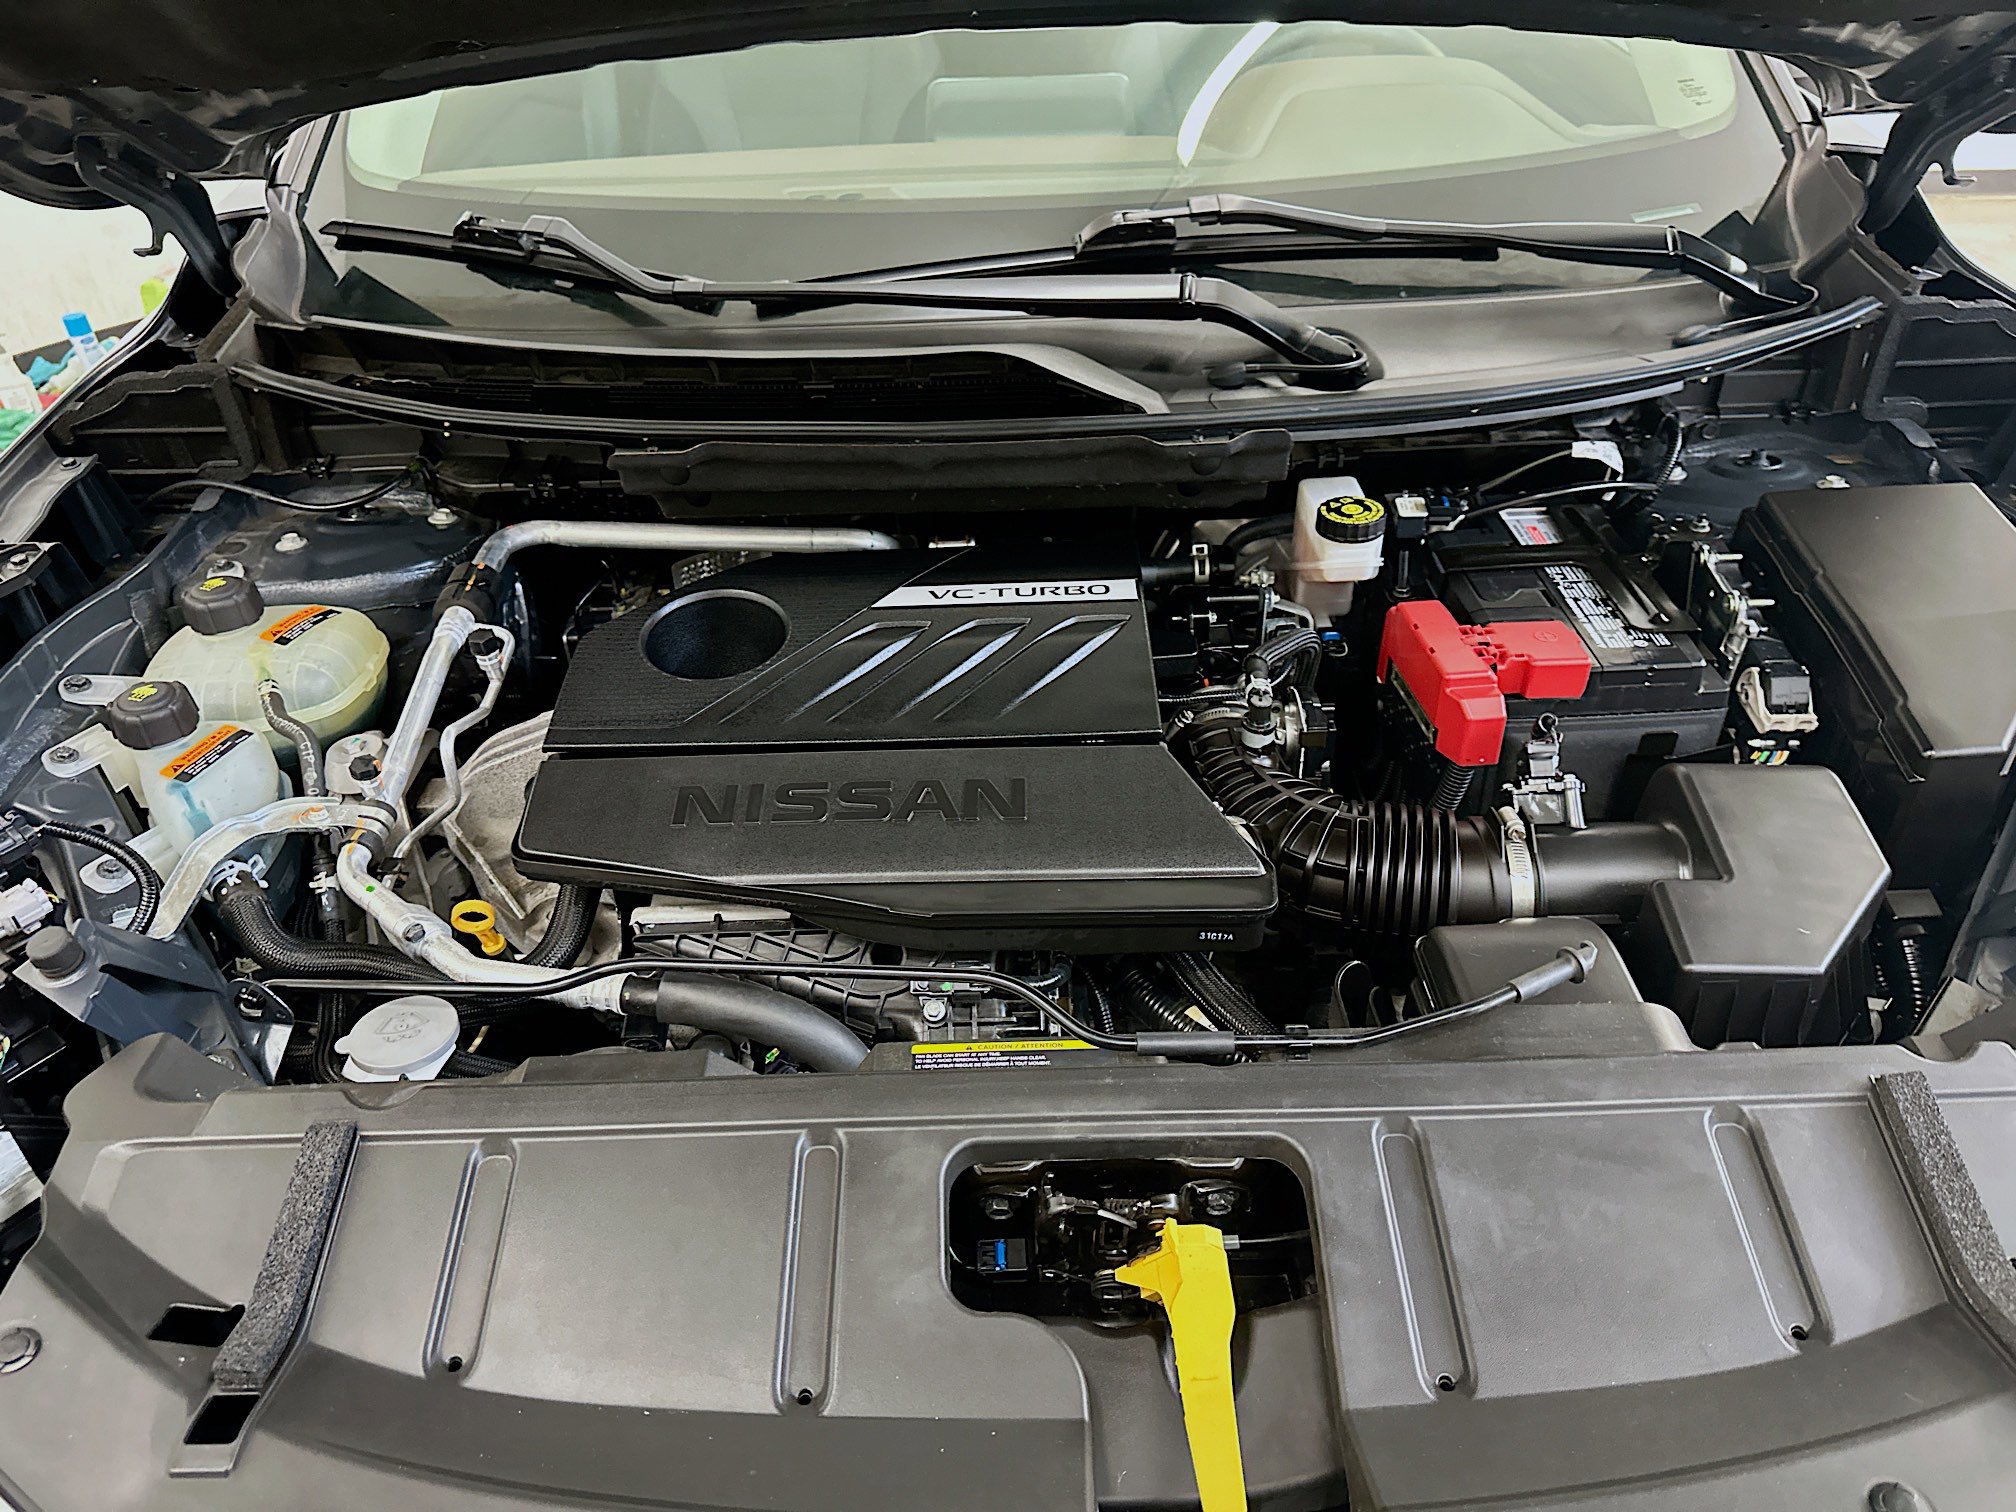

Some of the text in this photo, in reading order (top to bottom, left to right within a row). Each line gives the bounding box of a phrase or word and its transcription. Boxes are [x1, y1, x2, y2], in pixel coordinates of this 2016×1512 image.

[927, 584, 1111, 600] VC-TURBO
[670, 777, 1029, 828] NISSAN
[977, 1043, 1013, 1051] CAUTION
[982, 1060, 1009, 1068] DÉMARRER
